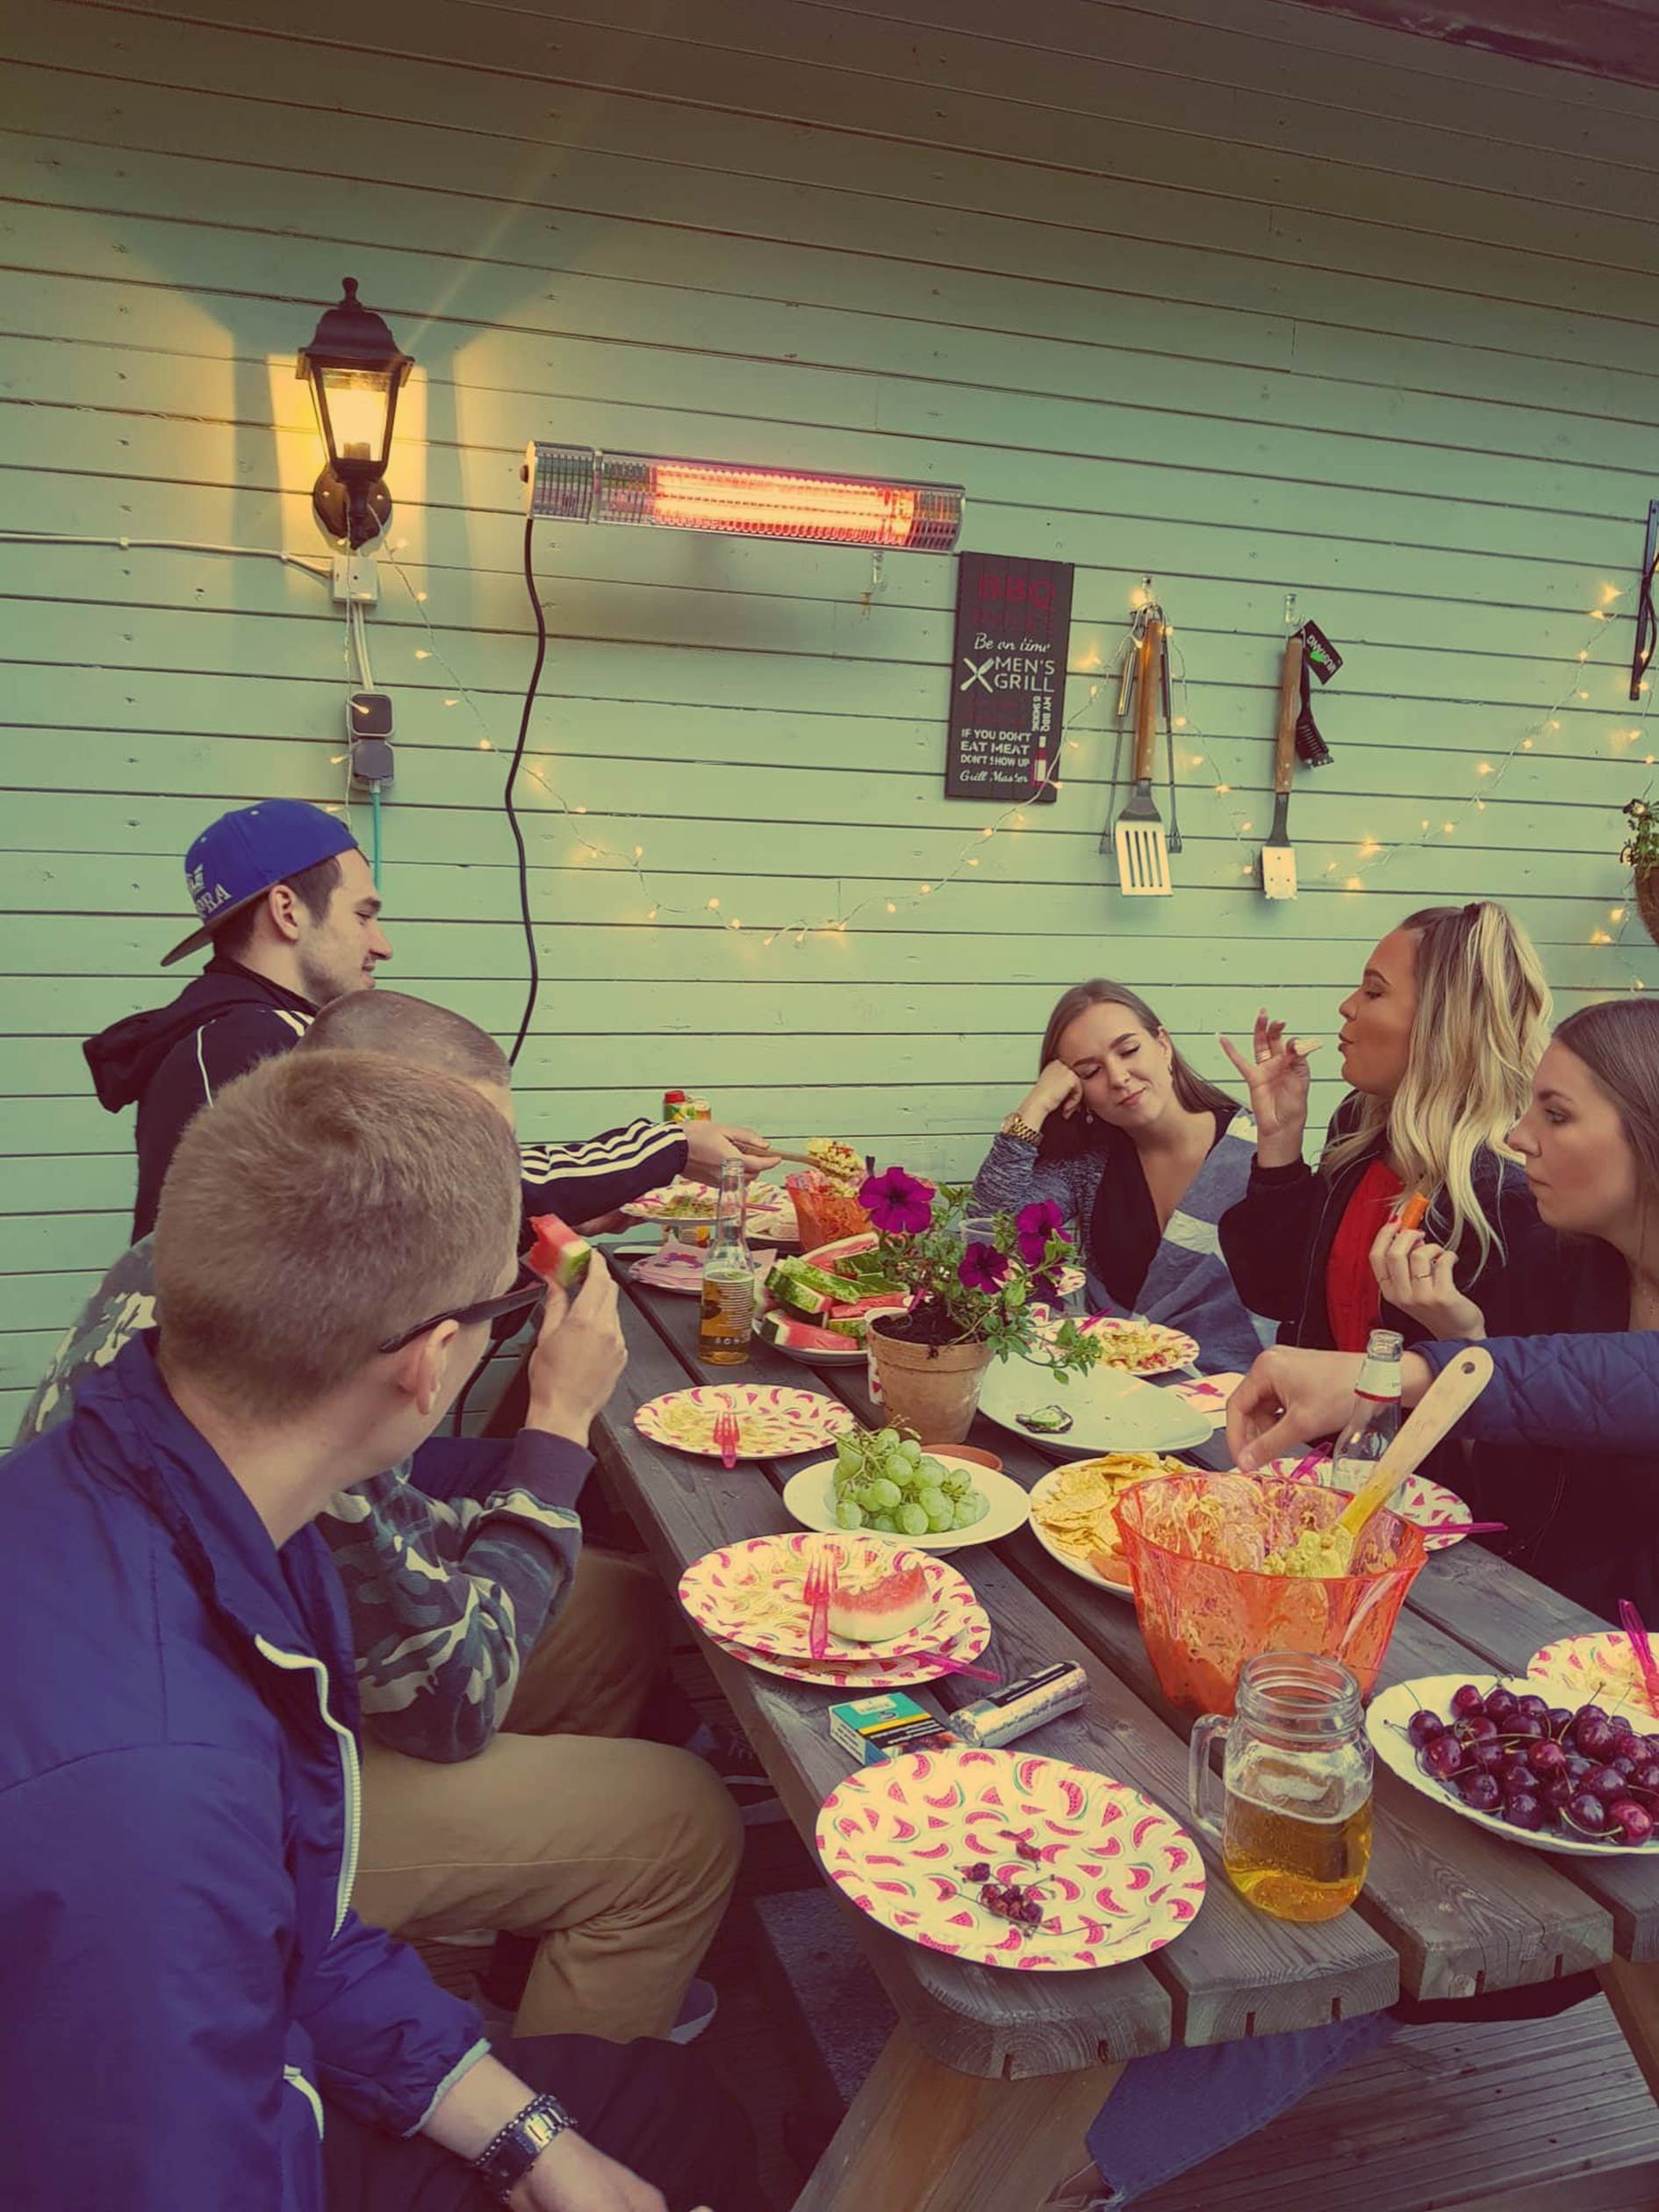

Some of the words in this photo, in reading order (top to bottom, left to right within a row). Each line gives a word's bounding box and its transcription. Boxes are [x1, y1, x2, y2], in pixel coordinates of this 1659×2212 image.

[974, 632, 994, 650] Be
[995, 656, 1055, 675] MEN'S
[994, 672, 1055, 693] GRILL
[961, 729, 972, 738] IF
[973, 729, 996, 740] YOU
[999, 731, 1031, 743] DON'T
[960, 741, 988, 752] EAT
[990, 743, 1031, 756] MEAT
[960, 754, 988, 765] DON'T
[989, 756, 1016, 766] SHOW
[1017, 758, 1031, 767] UP
[959, 769, 988, 782] Grill
[989, 770, 1029, 783] Master
